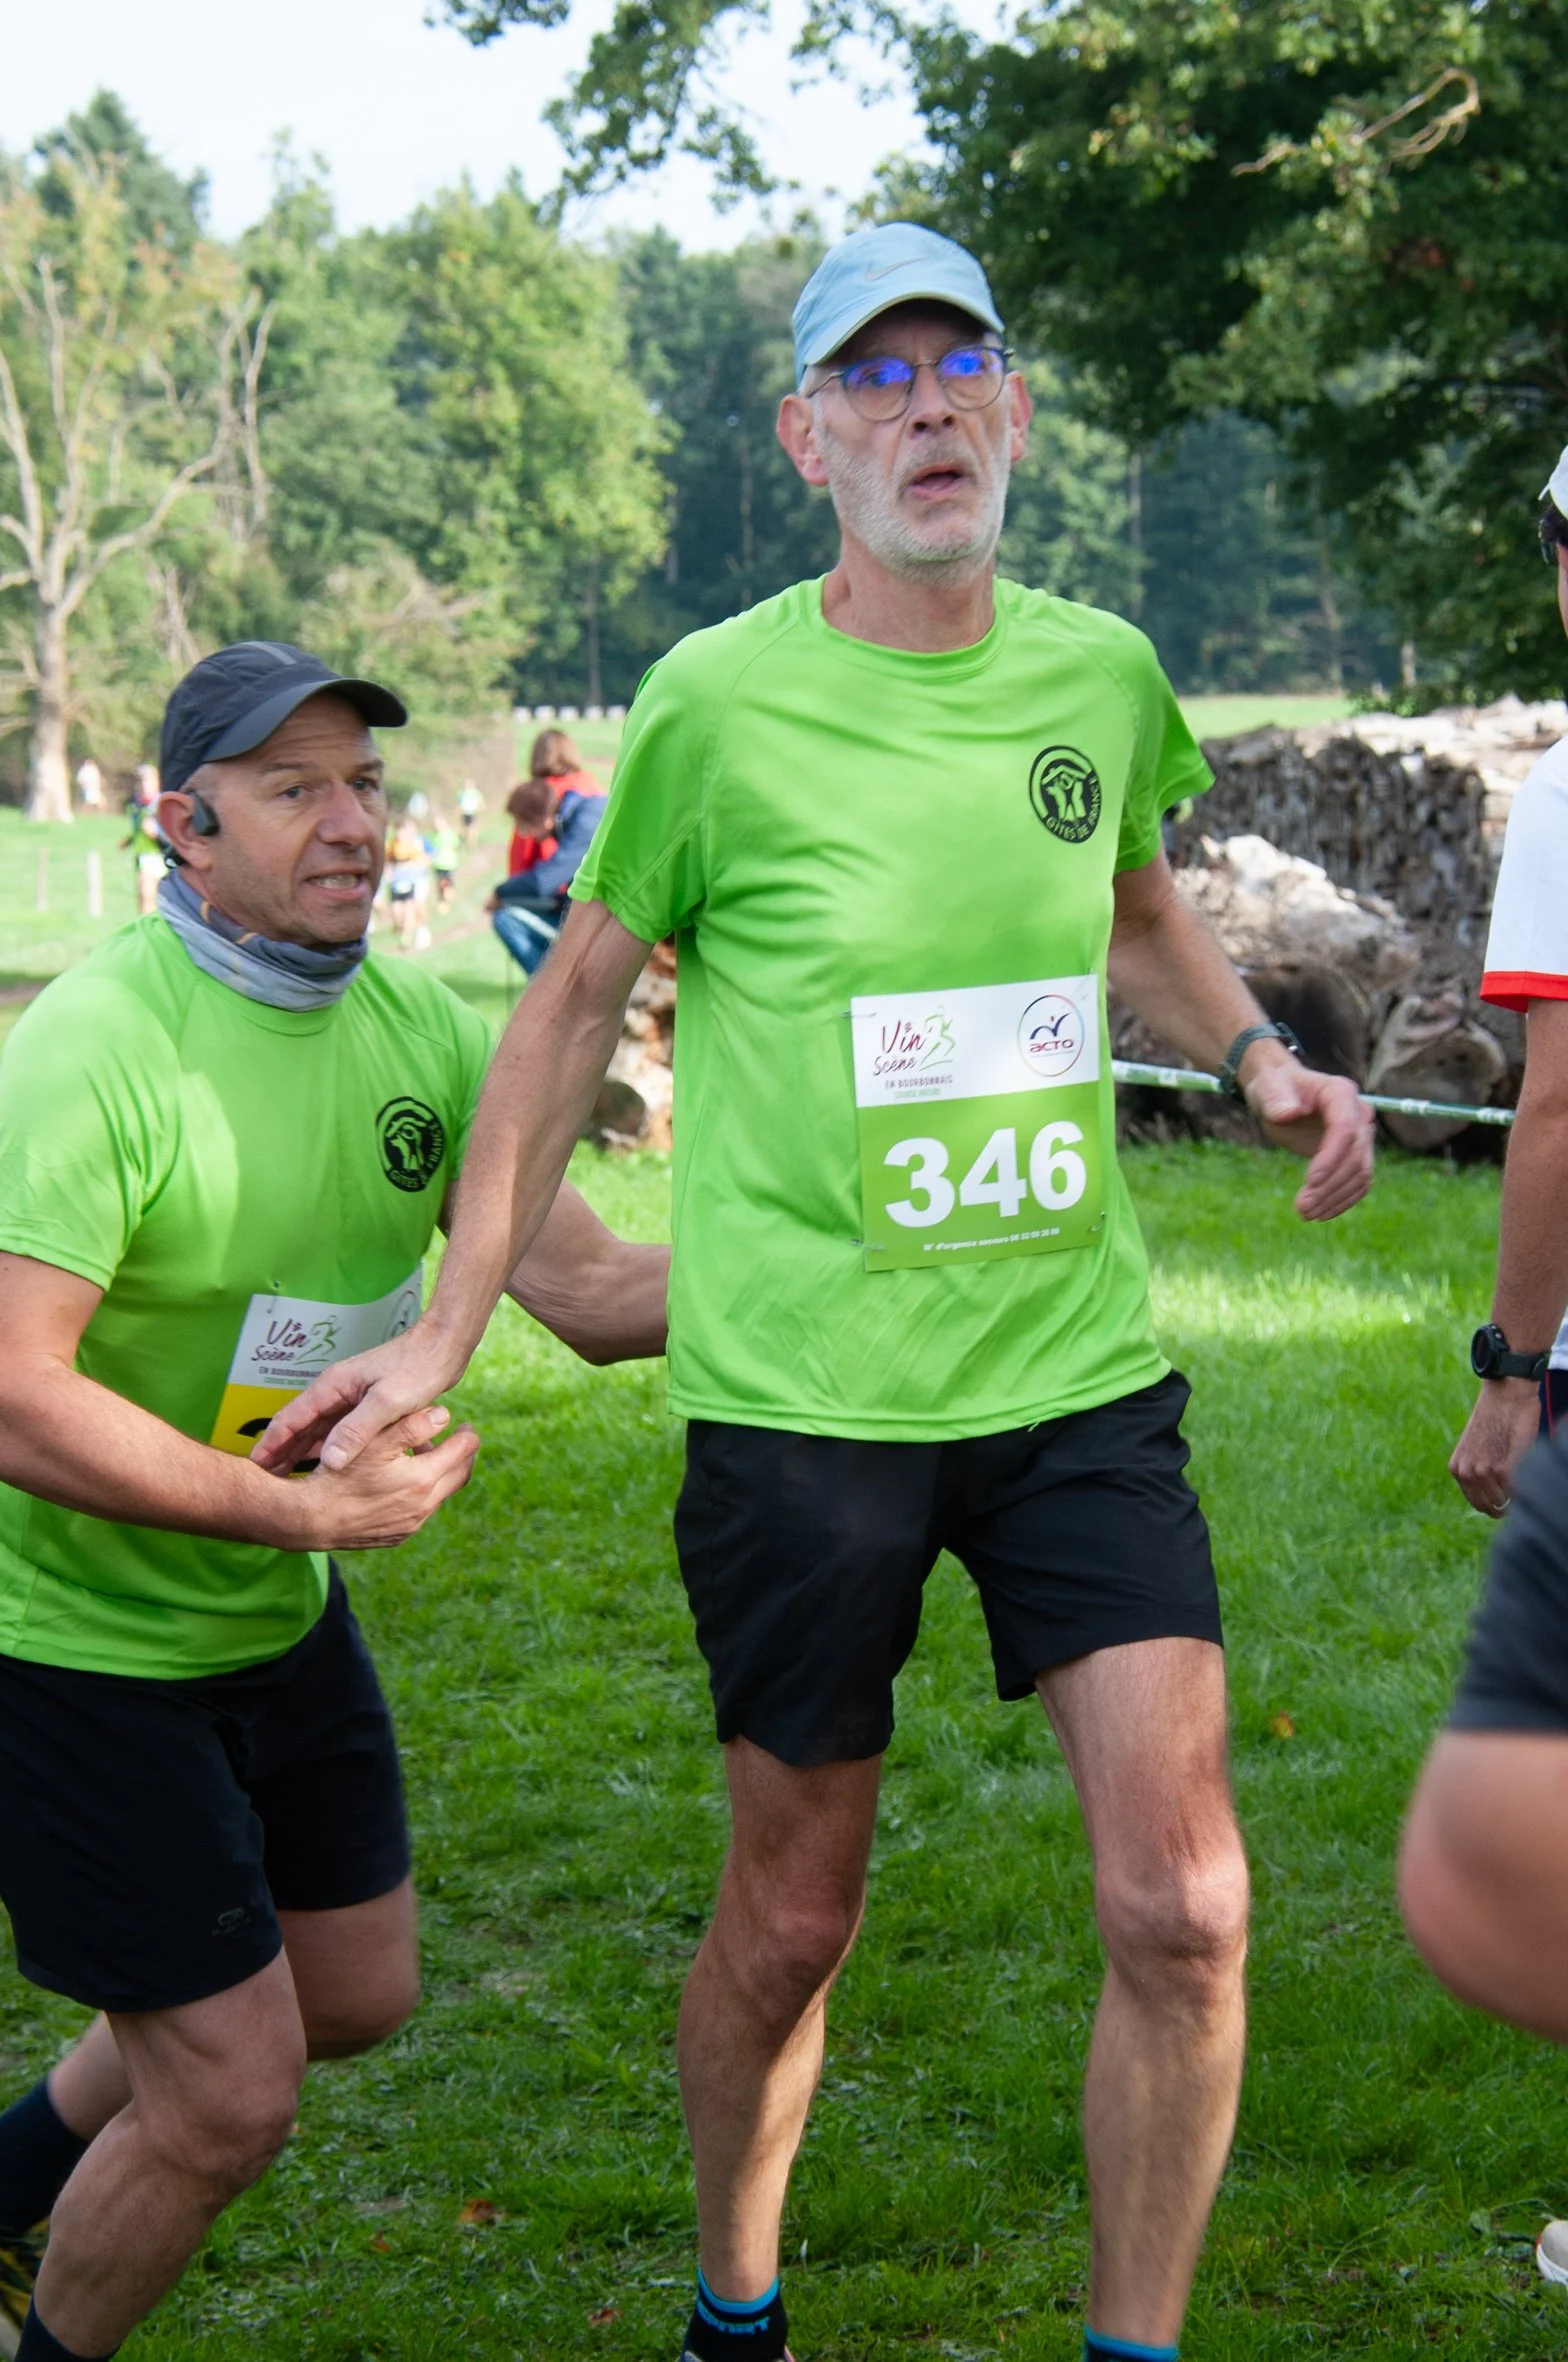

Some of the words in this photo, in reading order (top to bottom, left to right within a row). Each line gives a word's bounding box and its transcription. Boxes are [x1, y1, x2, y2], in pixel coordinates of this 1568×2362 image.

[881, 1018, 926, 1054] Vin
[883, 1120, 1087, 1228] 346
[266, 1318, 310, 1348] Vin
